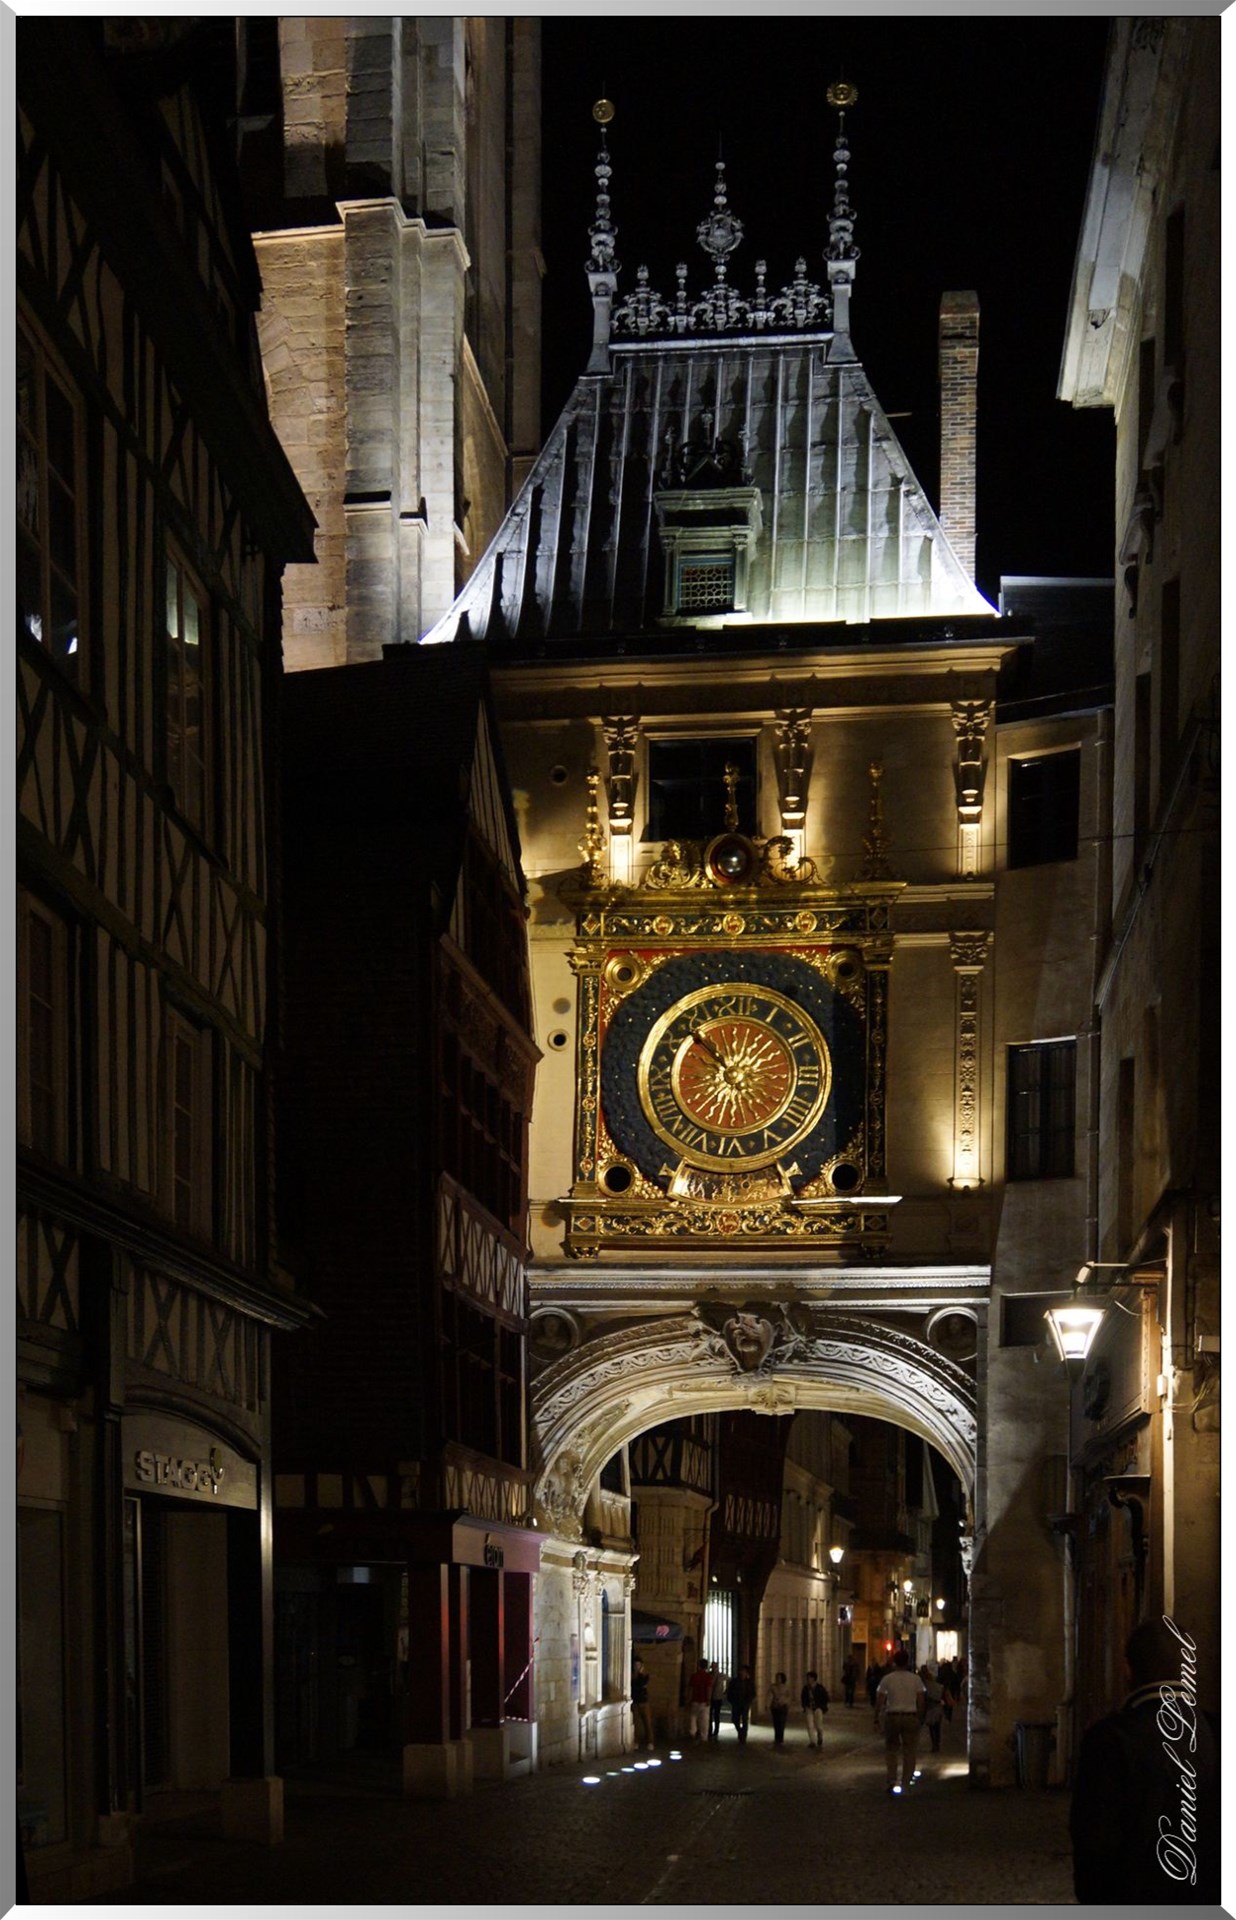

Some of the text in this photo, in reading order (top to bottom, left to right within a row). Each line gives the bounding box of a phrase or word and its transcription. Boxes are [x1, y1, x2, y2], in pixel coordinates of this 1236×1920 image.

[717, 997, 752, 1016] XII
[787, 1031, 810, 1049] II
[798, 1065, 819, 1086] III
[718, 1137, 747, 1156] VI
[763, 1129, 783, 1149] V
